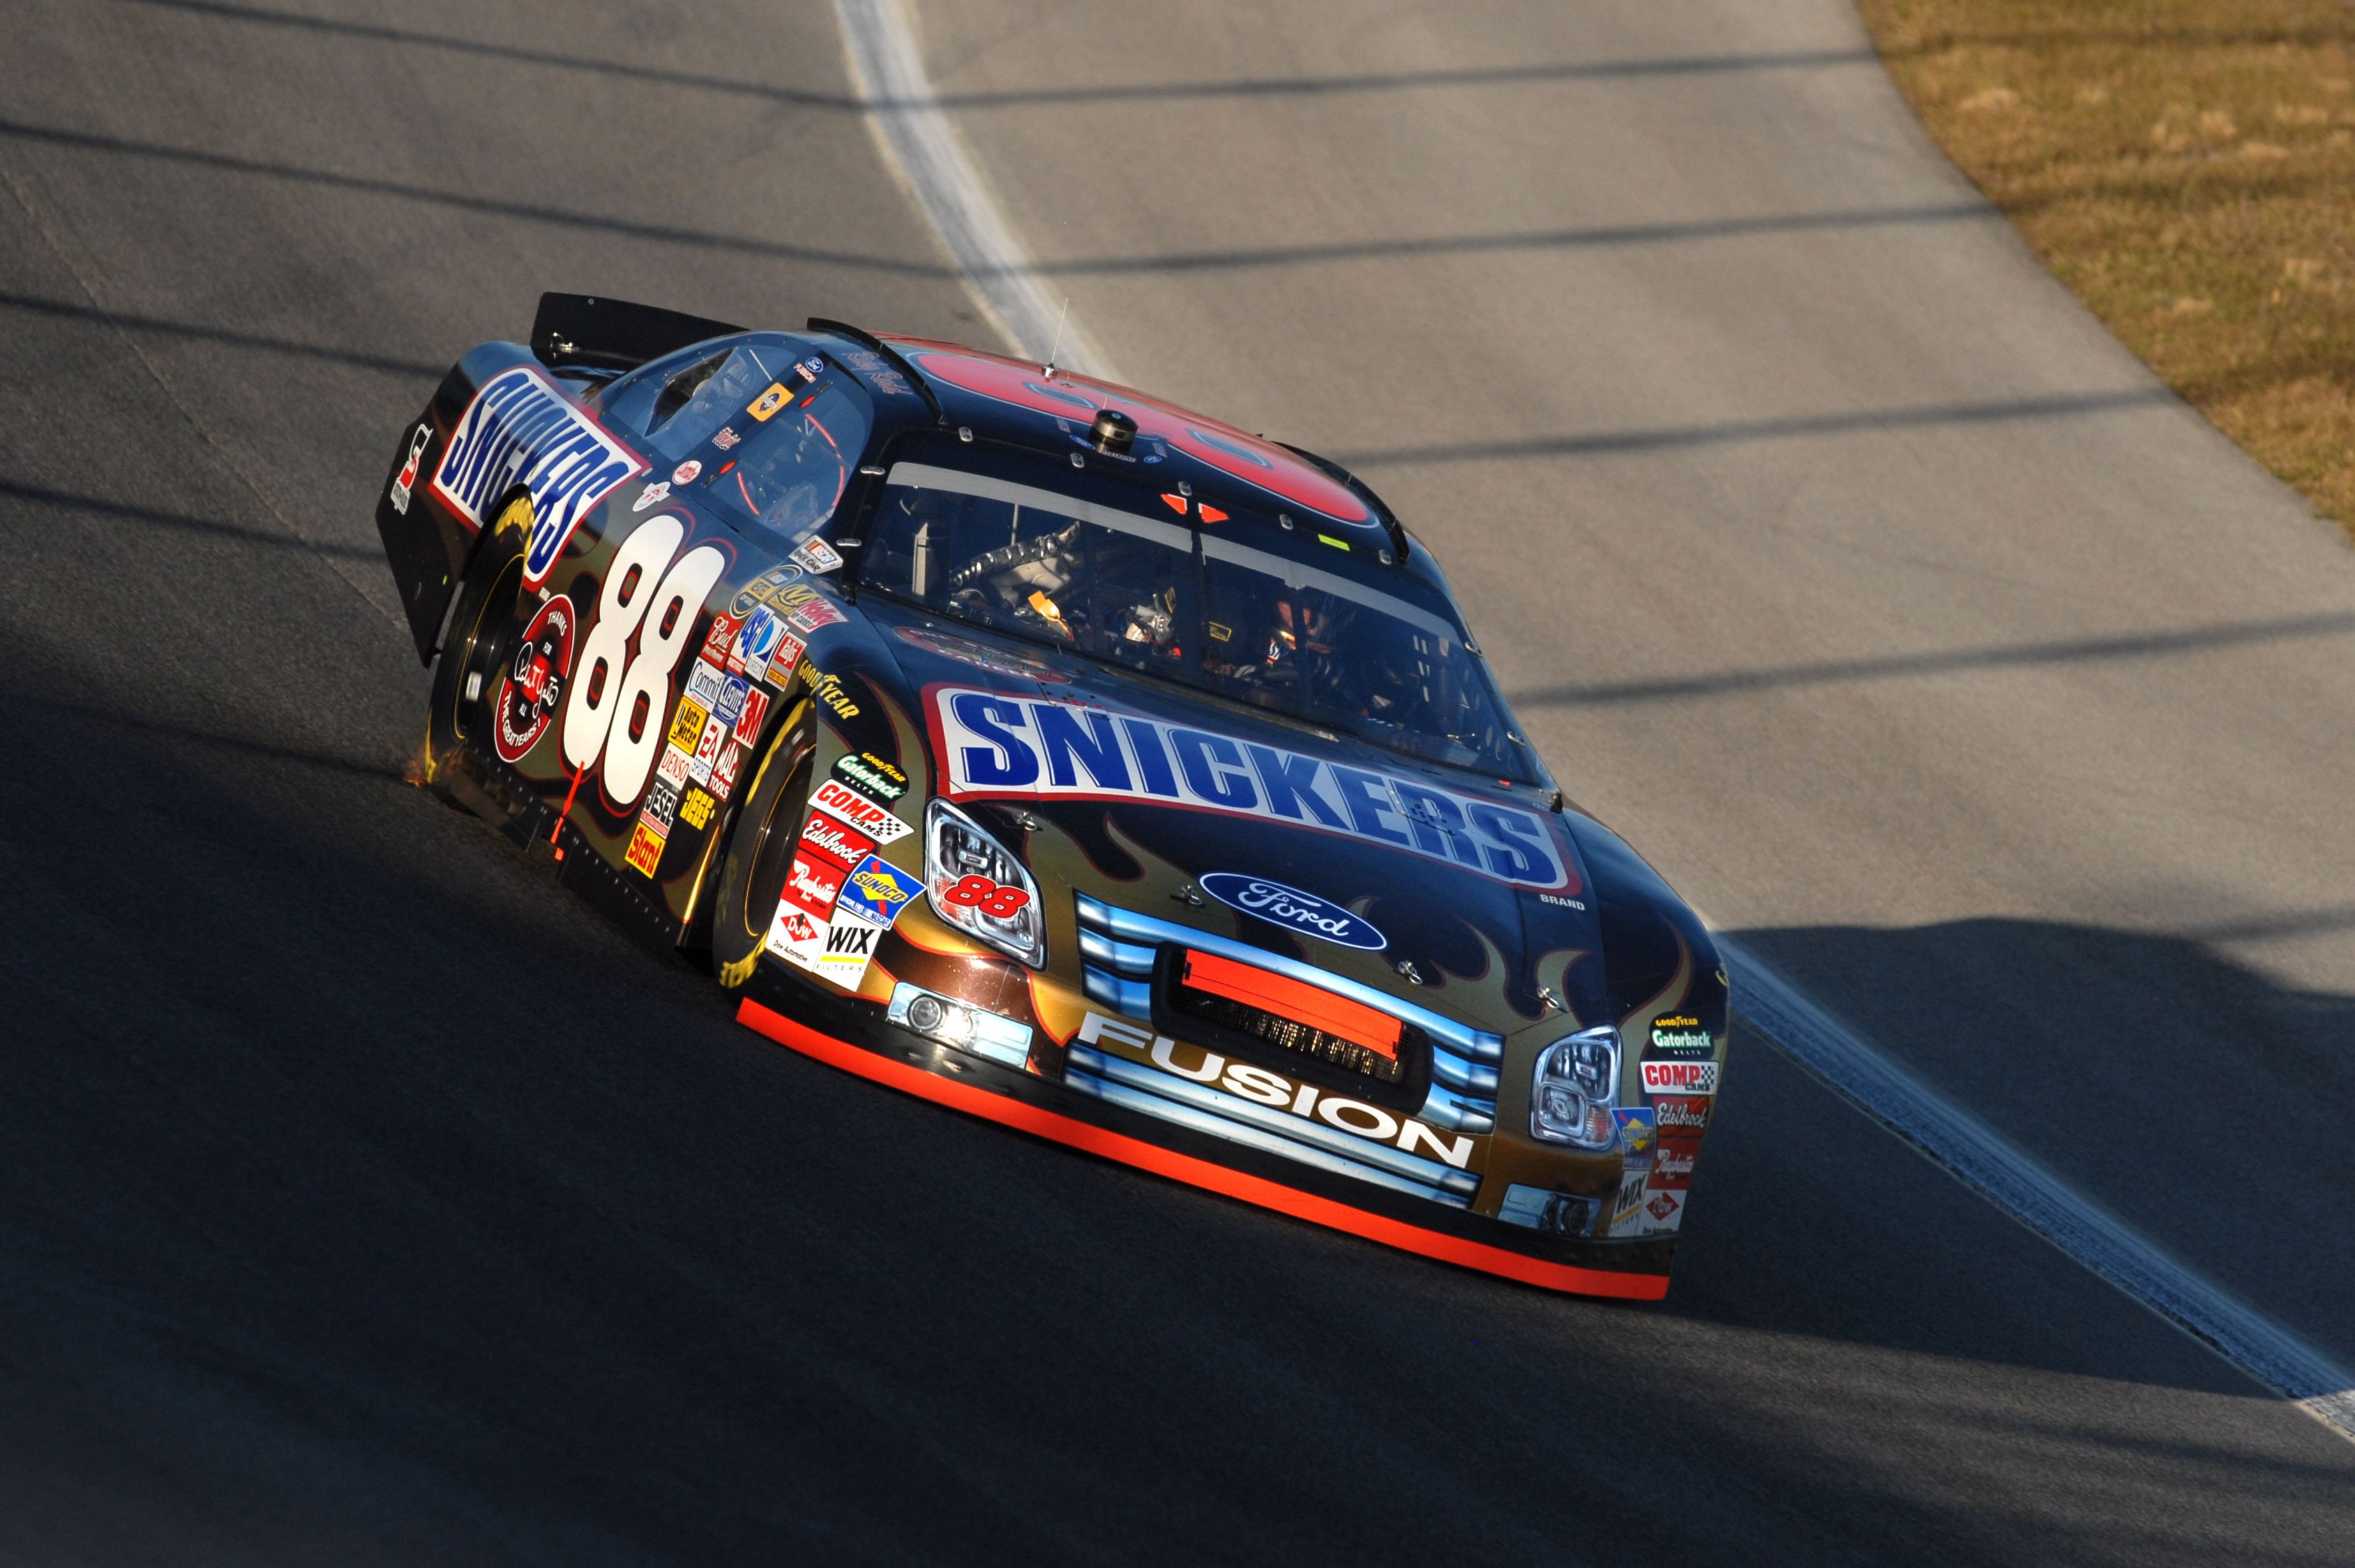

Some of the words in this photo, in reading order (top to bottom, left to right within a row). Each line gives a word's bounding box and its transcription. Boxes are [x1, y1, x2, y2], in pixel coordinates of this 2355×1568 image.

[794, 549, 806, 562] RACE
[806, 557, 820, 572] CAR
[548, 611, 567, 636] THANKS
[709, 617, 738, 649] Bud
[542, 641, 552, 656] FOR
[564, 514, 725, 804] 88
[689, 661, 724, 703] Commit
[718, 675, 744, 714] CLEVITE
[798, 659, 859, 720] GOODYEAR
[502, 691, 512, 723] THE
[518, 702, 527, 717] ALL
[684, 706, 700, 728] Auto
[736, 688, 768, 746] 3M
[674, 721, 697, 746] Meter
[698, 723, 720, 764] EA
[661, 749, 690, 782] DENSO
[691, 756, 712, 782] SPORTS
[836, 755, 903, 800] Gatorback
[862, 752, 905, 783] GOODYEAR
[709, 774, 731, 799] TOOLS
[844, 776, 875, 795] BELTS
[951, 693, 1558, 886] SNICKERS
[645, 782, 678, 827] JESEL
[679, 787, 716, 831] JEGS
[817, 783, 886, 823] COMP
[802, 818, 868, 864] Edelbrock
[850, 816, 884, 837] CAMS
[627, 827, 662, 873] Stant
[854, 871, 907, 903] SUNOCO
[942, 874, 1030, 921] 88
[1540, 894, 1586, 911] BRAND
[1237, 882, 1350, 937] Ford
[773, 940, 783, 949] Dow
[784, 944, 808, 963] Automotive
[826, 926, 875, 955] WIX
[815, 963, 863, 973] FILTERS
[1655, 1016, 1699, 1027] GOODYEAR
[1652, 1030, 1711, 1048] Gatorback
[1077, 1011, 1474, 1168] FUSION
[1645, 1064, 1701, 1087] COMP
[1685, 1083, 1710, 1092] CAMS
[1657, 1102, 1708, 1129] Edelbrock
[1616, 1173, 1648, 1214] WIX
